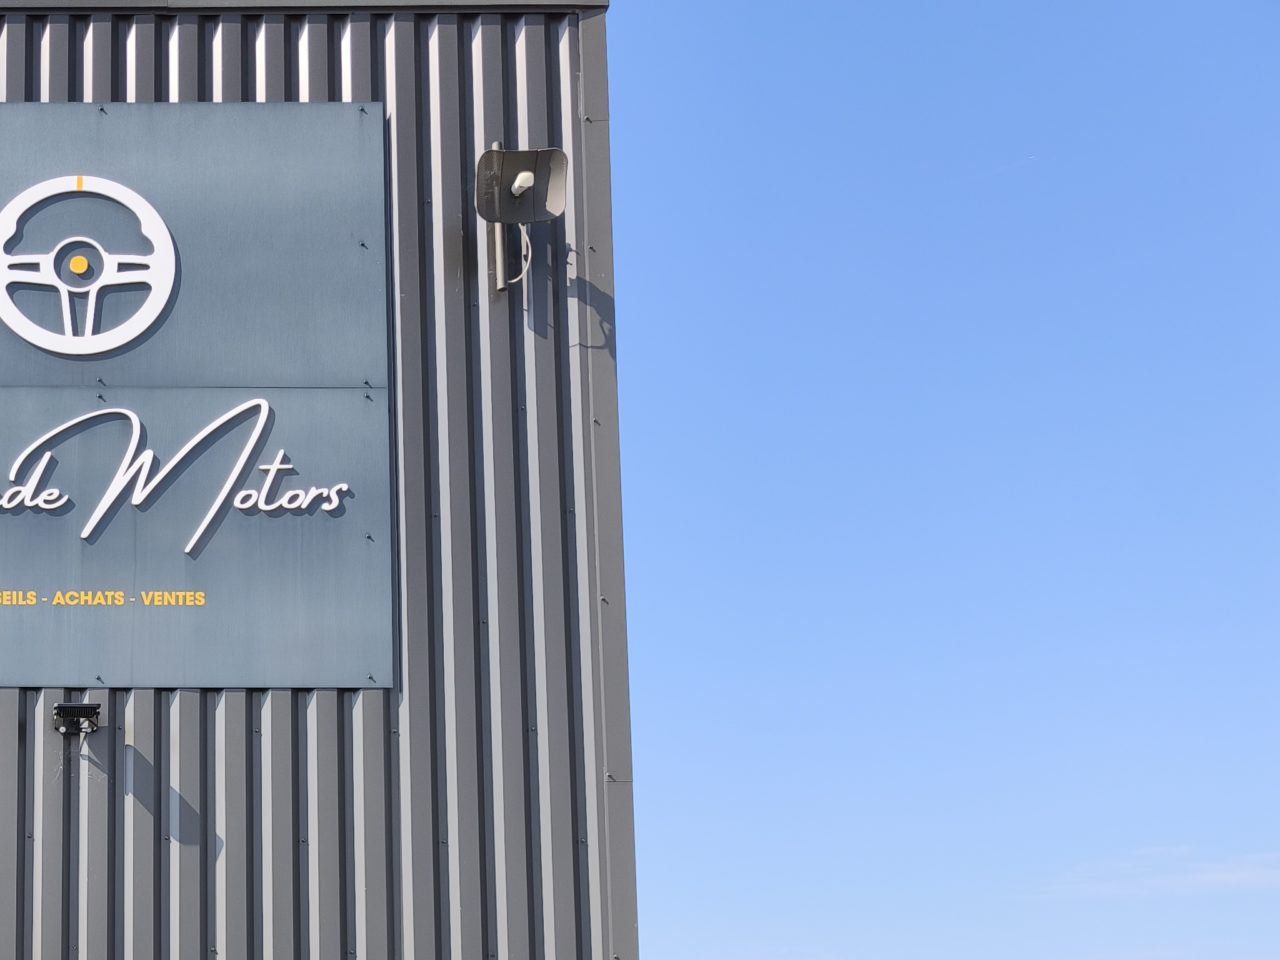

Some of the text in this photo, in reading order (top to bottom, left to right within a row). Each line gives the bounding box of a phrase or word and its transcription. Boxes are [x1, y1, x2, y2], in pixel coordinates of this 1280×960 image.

[10, 398, 349, 553] Motors
[52, 591, 125, 606] ACHATS
[140, 591, 206, 606] VENTES
